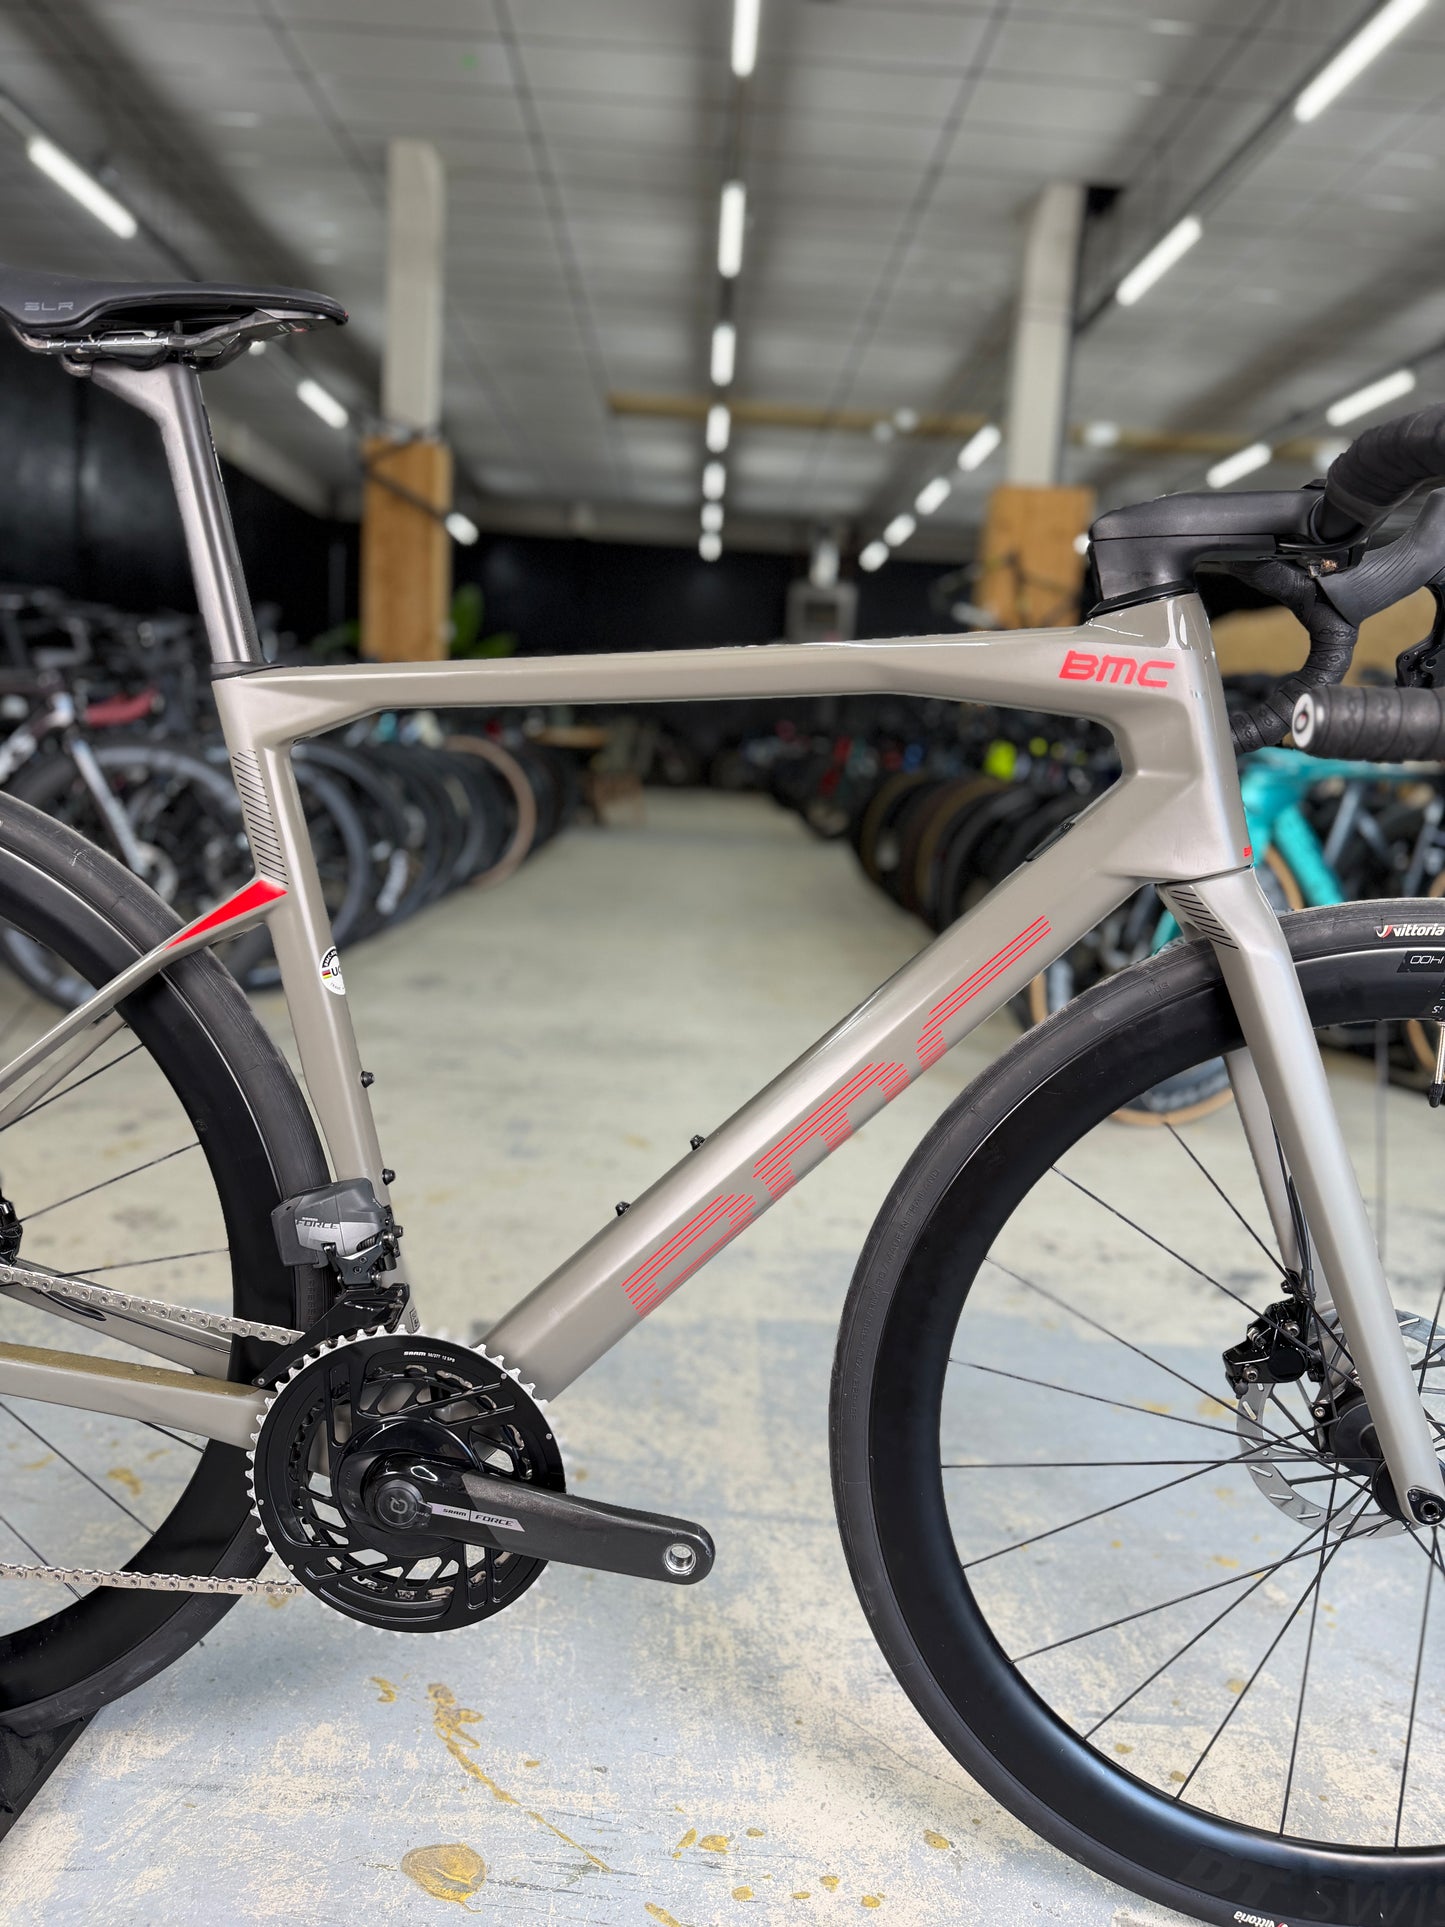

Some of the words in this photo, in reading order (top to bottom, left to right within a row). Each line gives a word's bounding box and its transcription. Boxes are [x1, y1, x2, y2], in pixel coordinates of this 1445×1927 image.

[1058, 650, 1176, 689] BMC
[1393, 923, 1445, 937] vittoria
[296, 1220, 339, 1230] FORCE
[443, 1508, 467, 1517] SRAM
[475, 1514, 513, 1526] FORCE
[1233, 1910, 1276, 1927] vittoria
